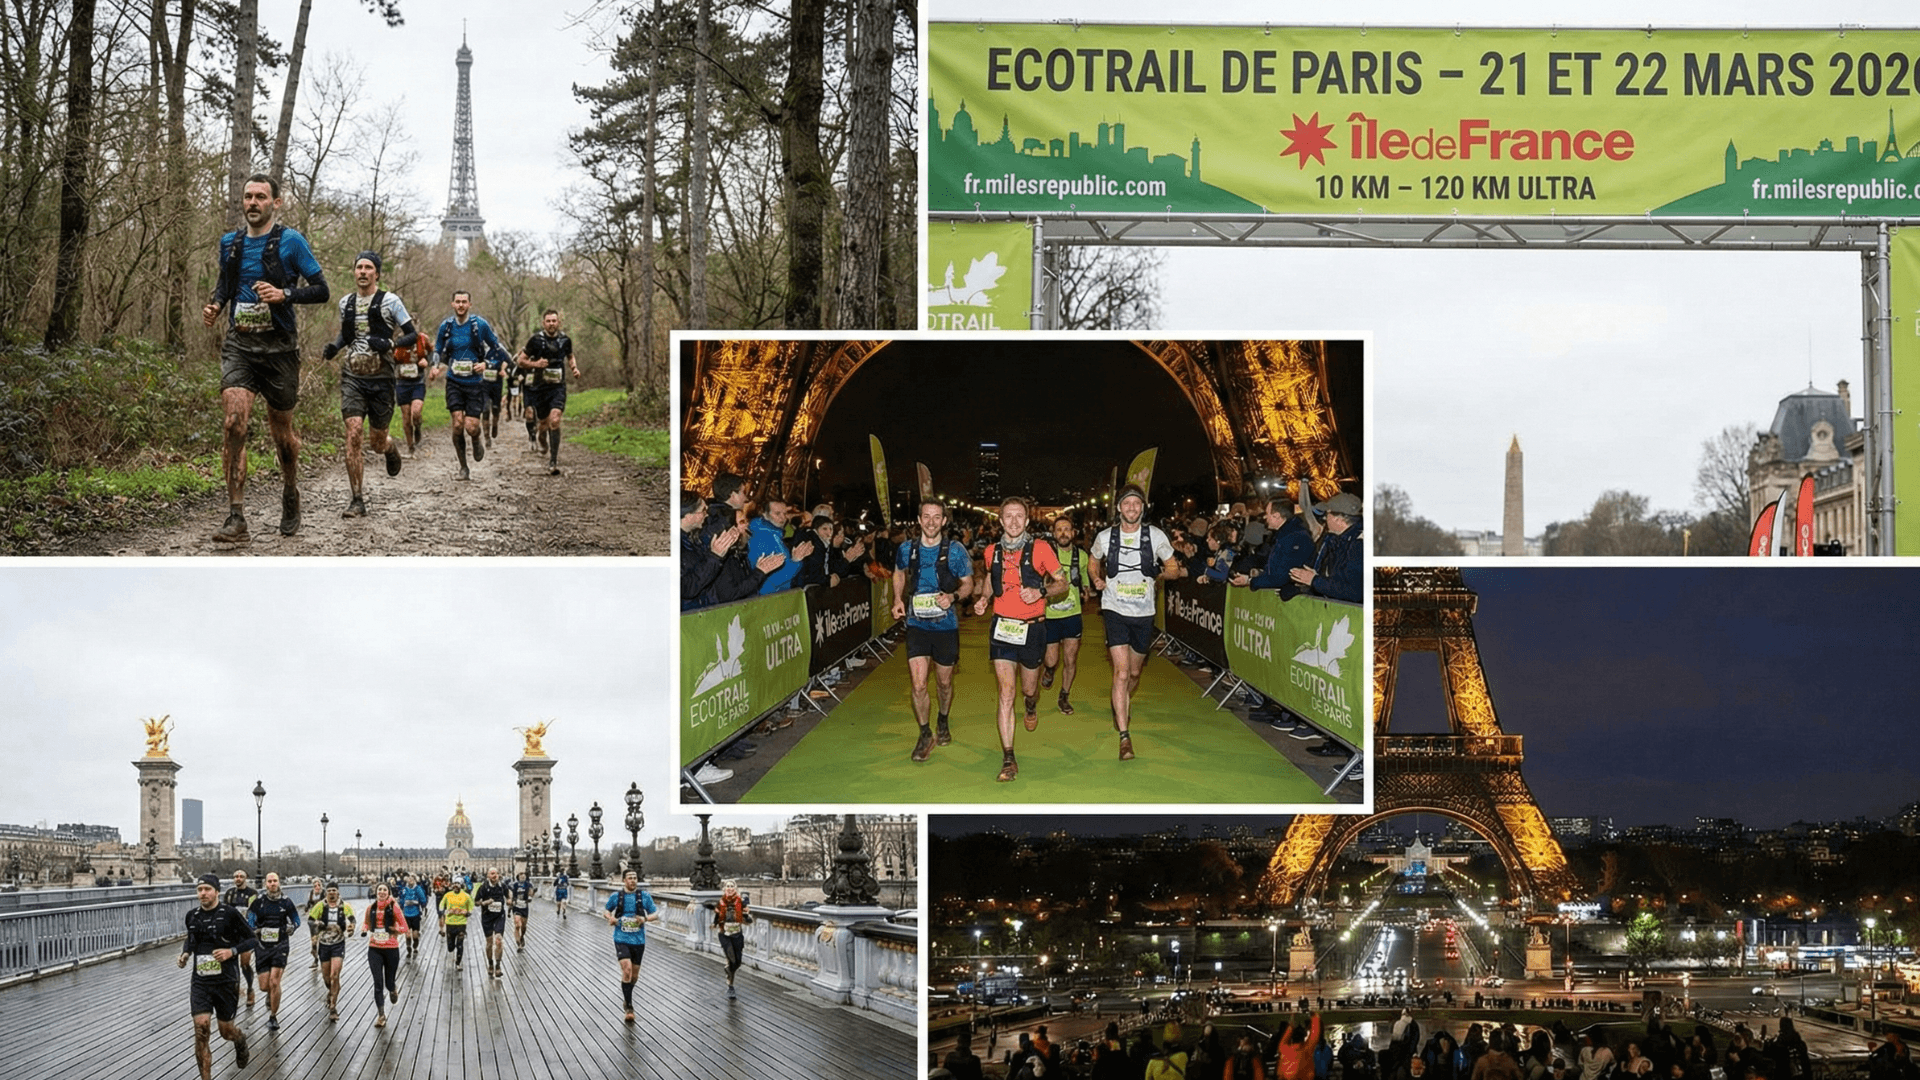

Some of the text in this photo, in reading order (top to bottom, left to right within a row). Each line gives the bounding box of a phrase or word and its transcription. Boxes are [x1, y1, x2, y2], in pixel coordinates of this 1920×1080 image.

[987, 47, 1206, 93] ECOTRAIL
[1222, 49, 1277, 93] DE
[1292, 50, 1422, 95] PARIS
[1479, 51, 1526, 96] 21
[1549, 52, 1601, 96] ET
[1614, 51, 1668, 96] 22
[1684, 51, 1815, 96] MARS
[1829, 51, 1920, 96] 202
[964, 173, 1167, 200] fr.milesrepublic.com
[1315, 175, 1343, 199] 10
[1352, 175, 1390, 199] KM
[1421, 175, 1464, 200] 120
[1472, 176, 1510, 200] KM
[1518, 176, 1597, 200] ULTRA
[766, 631, 803, 671] ULTRA
[1234, 623, 1272, 663] ULTRA
[690, 679, 749, 729] ECOTRAIL
[1290, 665, 1351, 712] ECOTRAIL
[1323, 702, 1353, 729] PARIS
